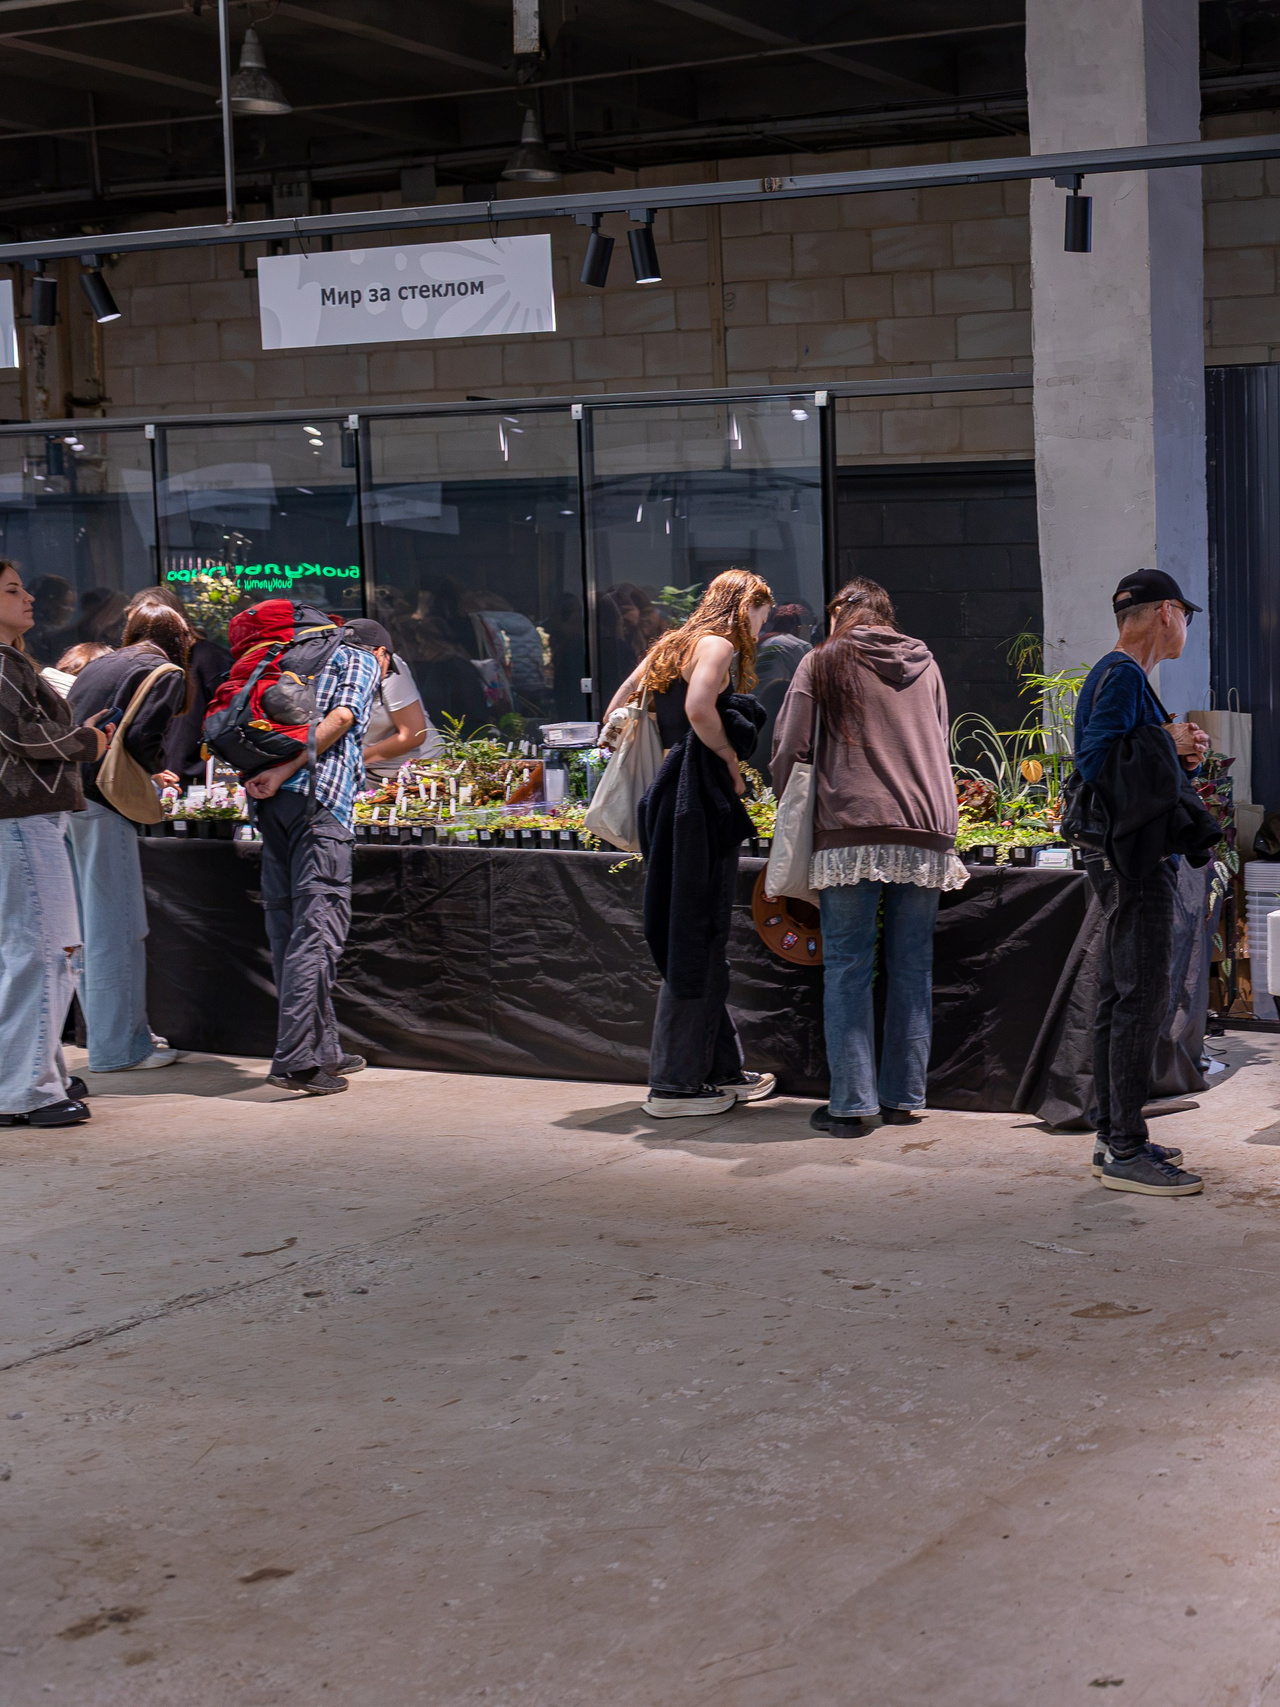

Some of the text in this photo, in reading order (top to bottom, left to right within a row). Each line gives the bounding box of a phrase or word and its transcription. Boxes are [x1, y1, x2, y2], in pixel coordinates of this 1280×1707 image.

[320, 280, 485, 309] Мир за стеклом
